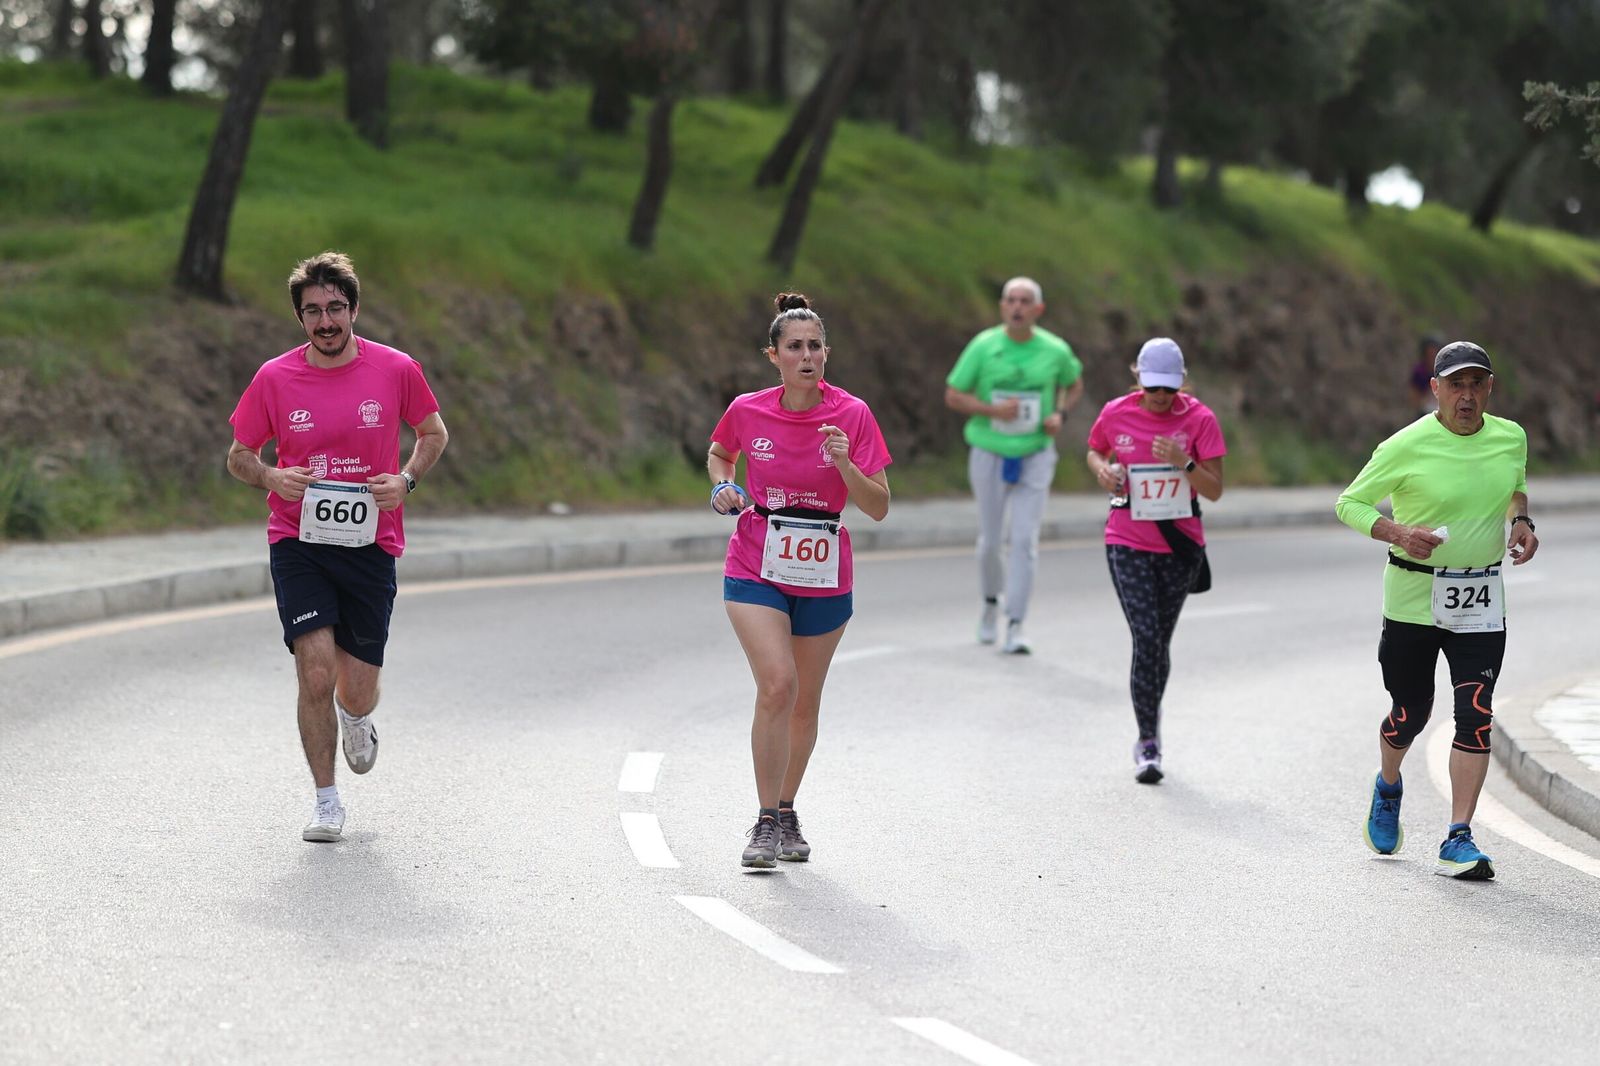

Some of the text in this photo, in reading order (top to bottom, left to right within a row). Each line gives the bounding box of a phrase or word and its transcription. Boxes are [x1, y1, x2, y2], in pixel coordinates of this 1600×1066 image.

[331, 456, 360, 465] Ciudad
[331, 464, 371, 474] de Málaga
[1140, 478, 1181, 499] 177
[315, 499, 367, 524] 660
[800, 498, 828, 508] Málaga
[778, 535, 830, 563] 160
[1444, 584, 1491, 610] 324
[292, 610, 319, 624] LEGEA
